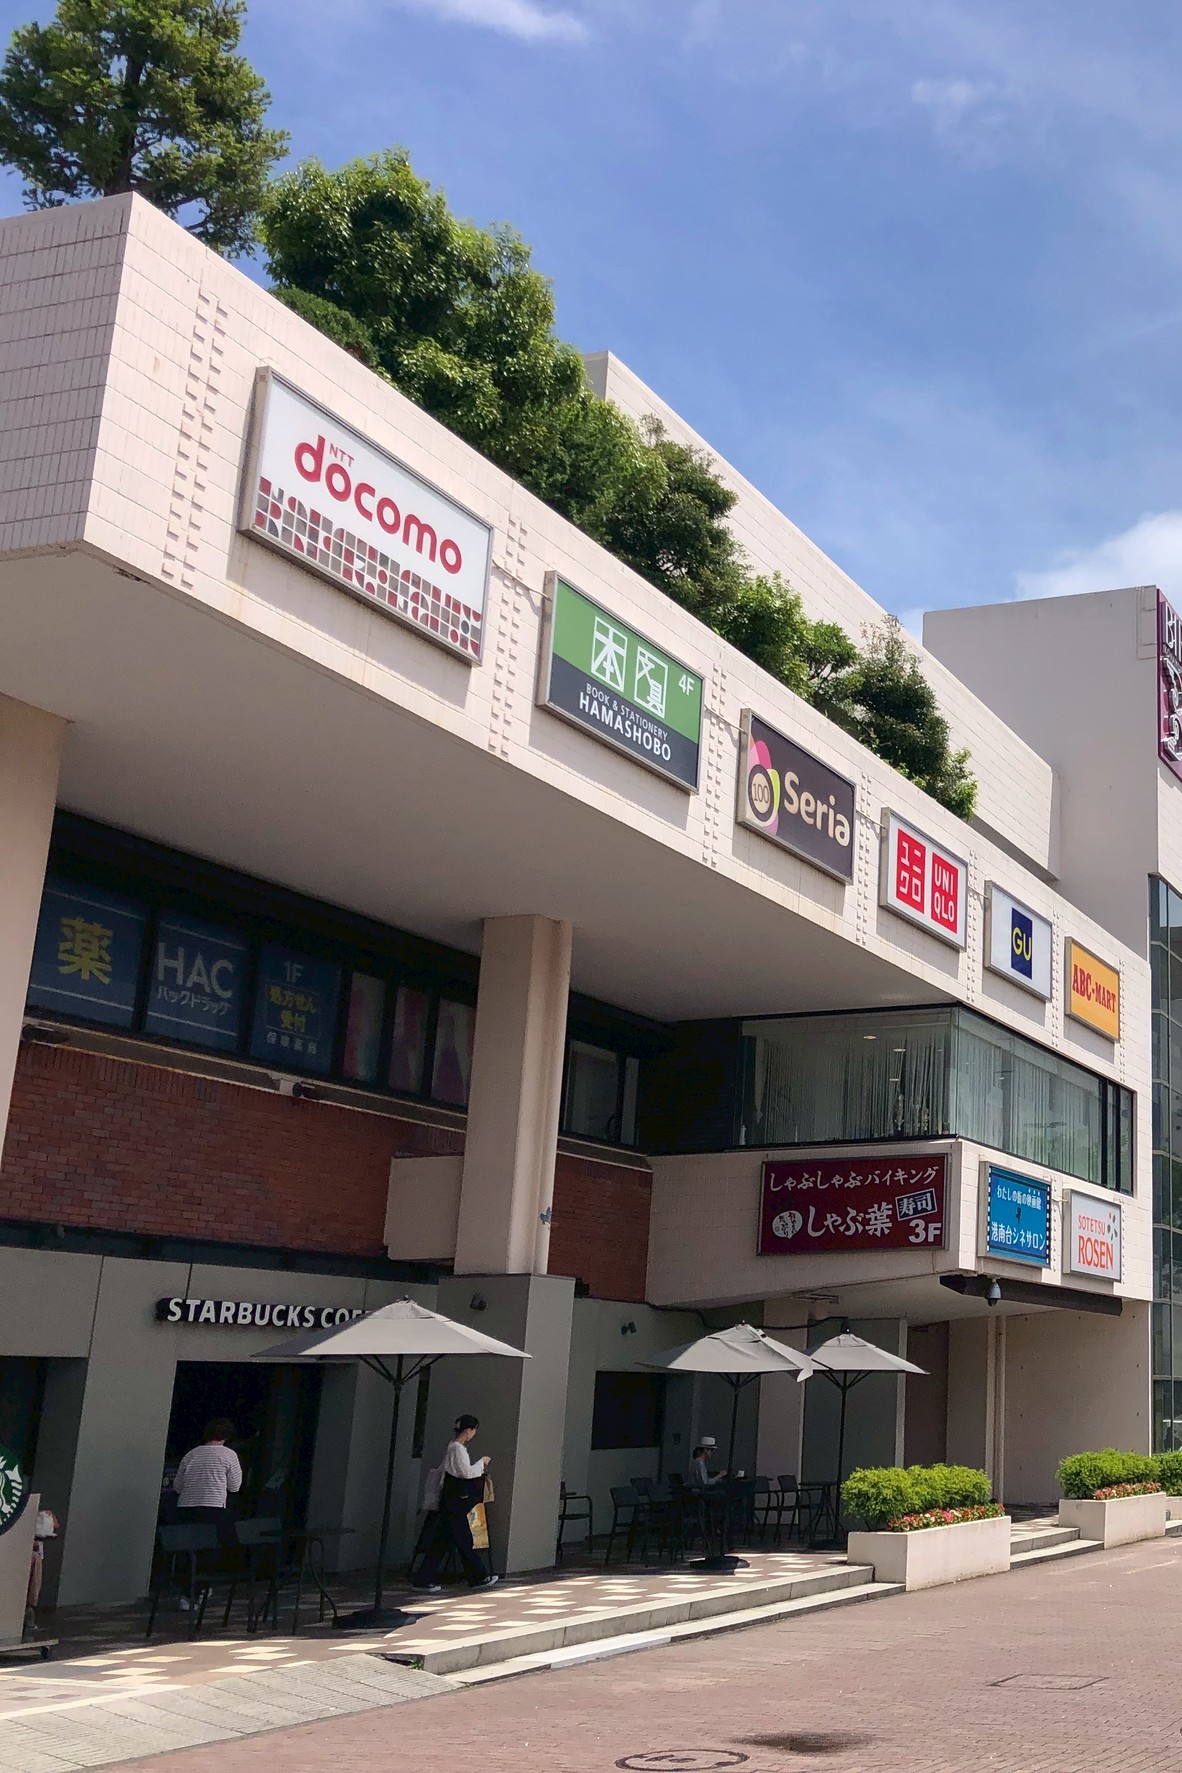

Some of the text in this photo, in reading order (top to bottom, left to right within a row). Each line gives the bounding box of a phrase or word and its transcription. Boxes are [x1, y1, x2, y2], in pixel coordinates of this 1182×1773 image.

[328, 442, 356, 468] NTT
[294, 434, 463, 575] docomo
[678, 674, 695, 697] 4F
[578, 691, 672, 762] HAMASHOBO
[585, 682, 669, 742] BOOK & STATIONERY
[752, 780, 770, 805] 100
[784, 771, 851, 848] Seria
[57, 916, 114, 986] 薬
[1011, 926, 1031, 961] GU
[158, 942, 234, 999] HAC
[284, 961, 305, 983] 1F
[1072, 963, 1117, 1014] ABC-MART
[769, 1165, 939, 1192] しゃぶしゃぶバイキング
[807, 1202, 893, 1237] しゃぶ葉
[898, 1192, 934, 1216] 寿司
[908, 1219, 942, 1243] 3F
[991, 1221, 1046, 1251] 港南台シネサロン
[1078, 1213, 1106, 1237] SOTETSU
[1078, 1234, 1114, 1270] ROSEN
[167, 1298, 316, 1328] STARBUCKS
